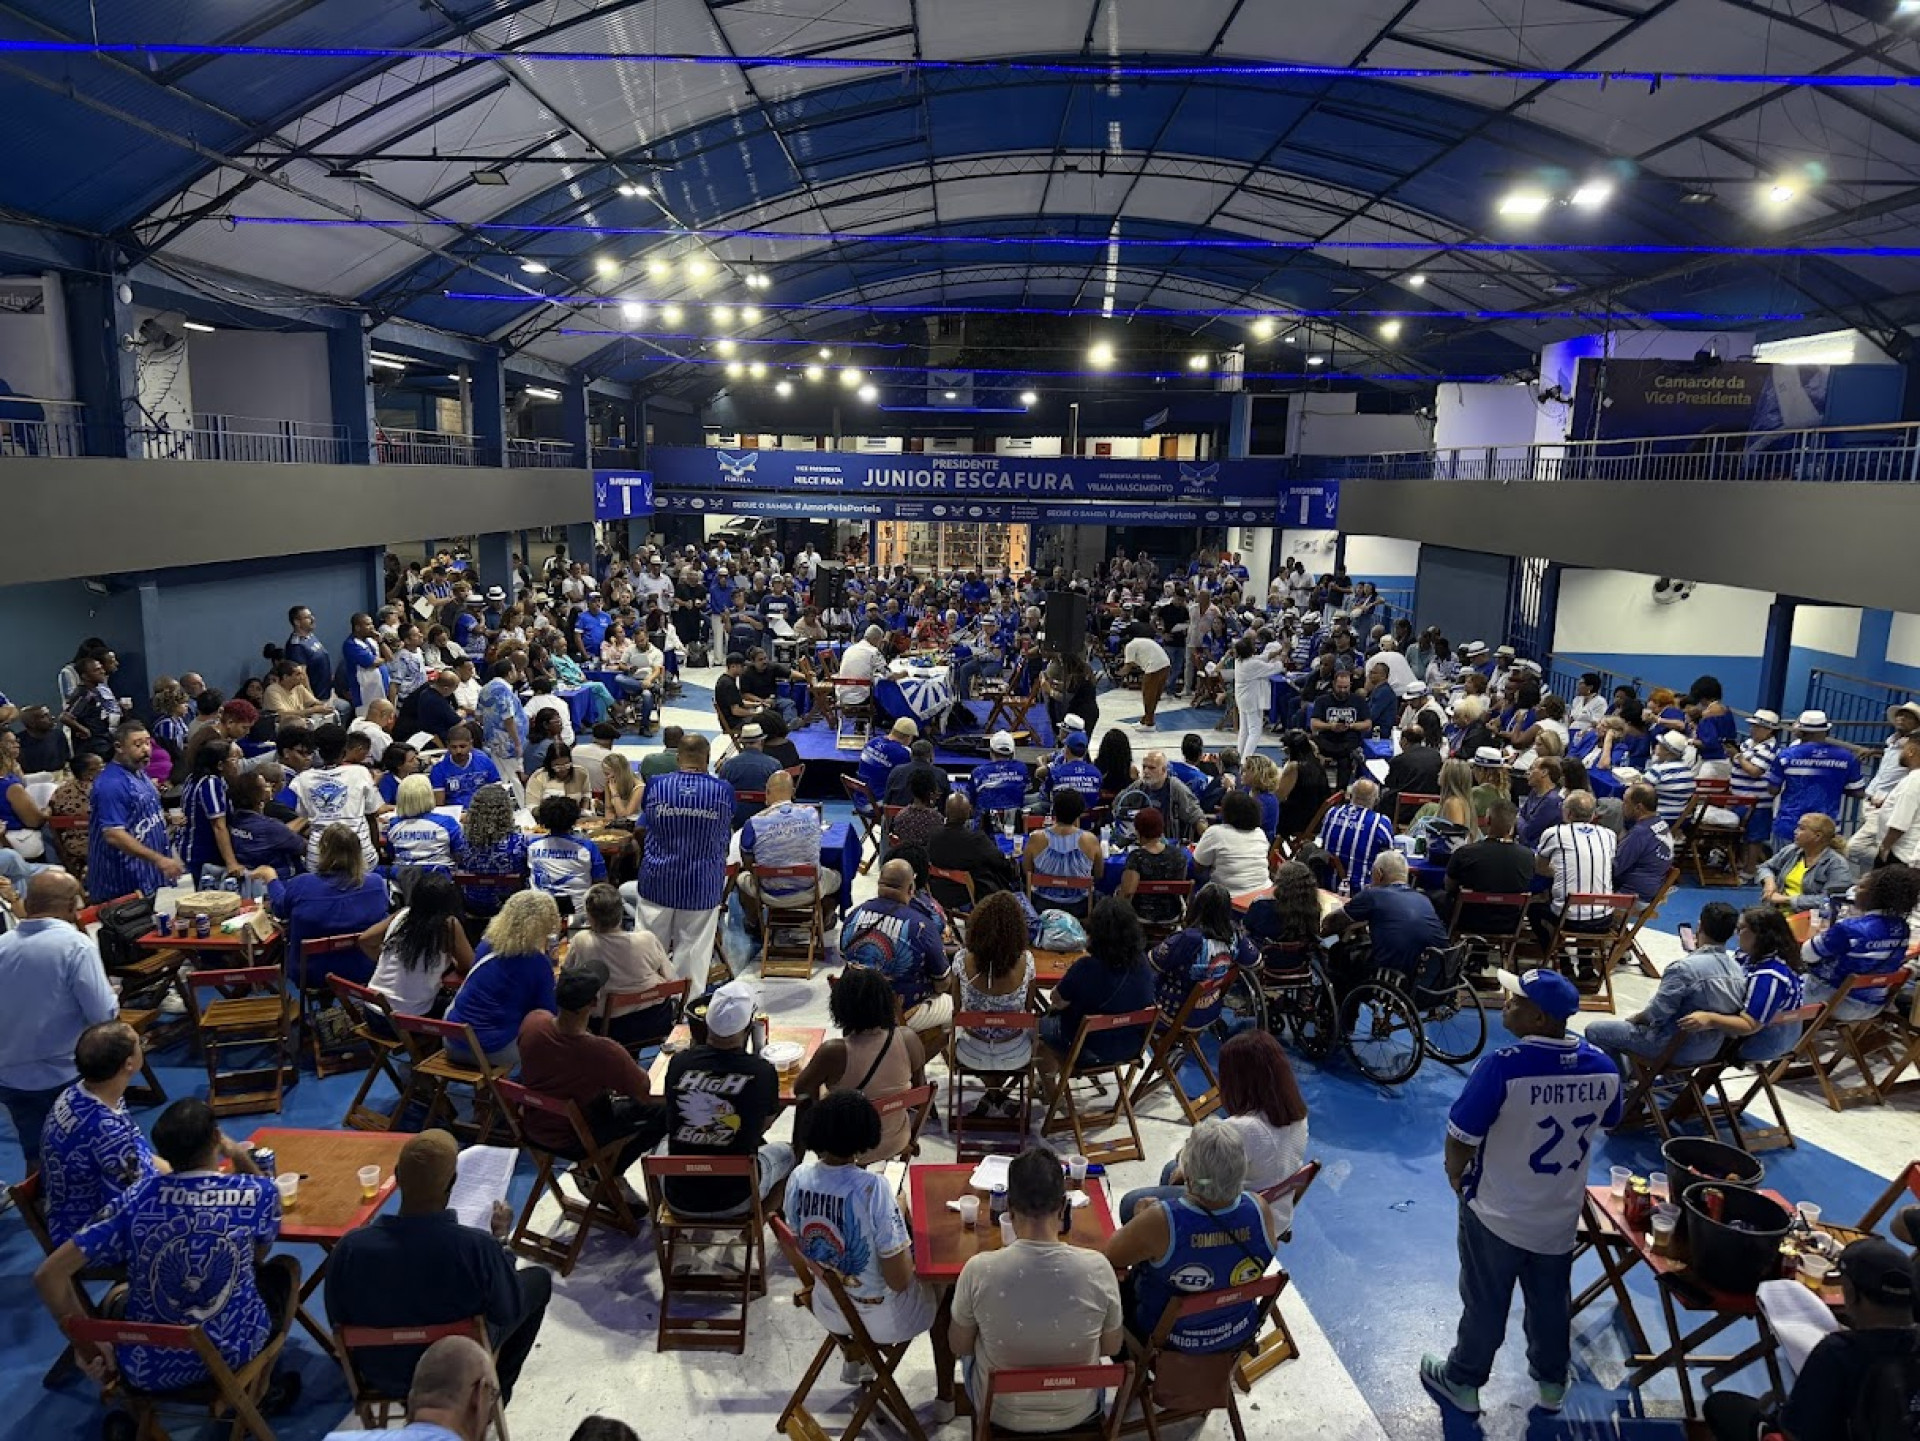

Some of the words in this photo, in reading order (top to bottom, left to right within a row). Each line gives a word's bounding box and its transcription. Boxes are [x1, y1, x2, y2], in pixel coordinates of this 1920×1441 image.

[1654, 375, 1724, 389] Camarote
[1726, 375, 1745, 389] da
[1644, 391, 1674, 405] Vice
[1676, 391, 1751, 405] Presidenta
[932, 459, 1000, 470] PRESIDENTE
[820, 476, 844, 485] FRAN
[862, 468, 946, 488] JUNIOR
[954, 471, 1074, 490] ESCAFURA
[1087, 483, 1114, 492] VILMA
[1115, 483, 1174, 493] NASCIMENTO
[795, 502, 882, 514] #AmorPelaPortela
[655, 802, 719, 820] Harmonia
[1529, 1081, 1607, 1106] PORTELA
[1528, 1112, 1598, 1176] 23
[158, 1186, 257, 1207] TORCIDA
[1043, 1377, 1076, 1387] BRAHMA
